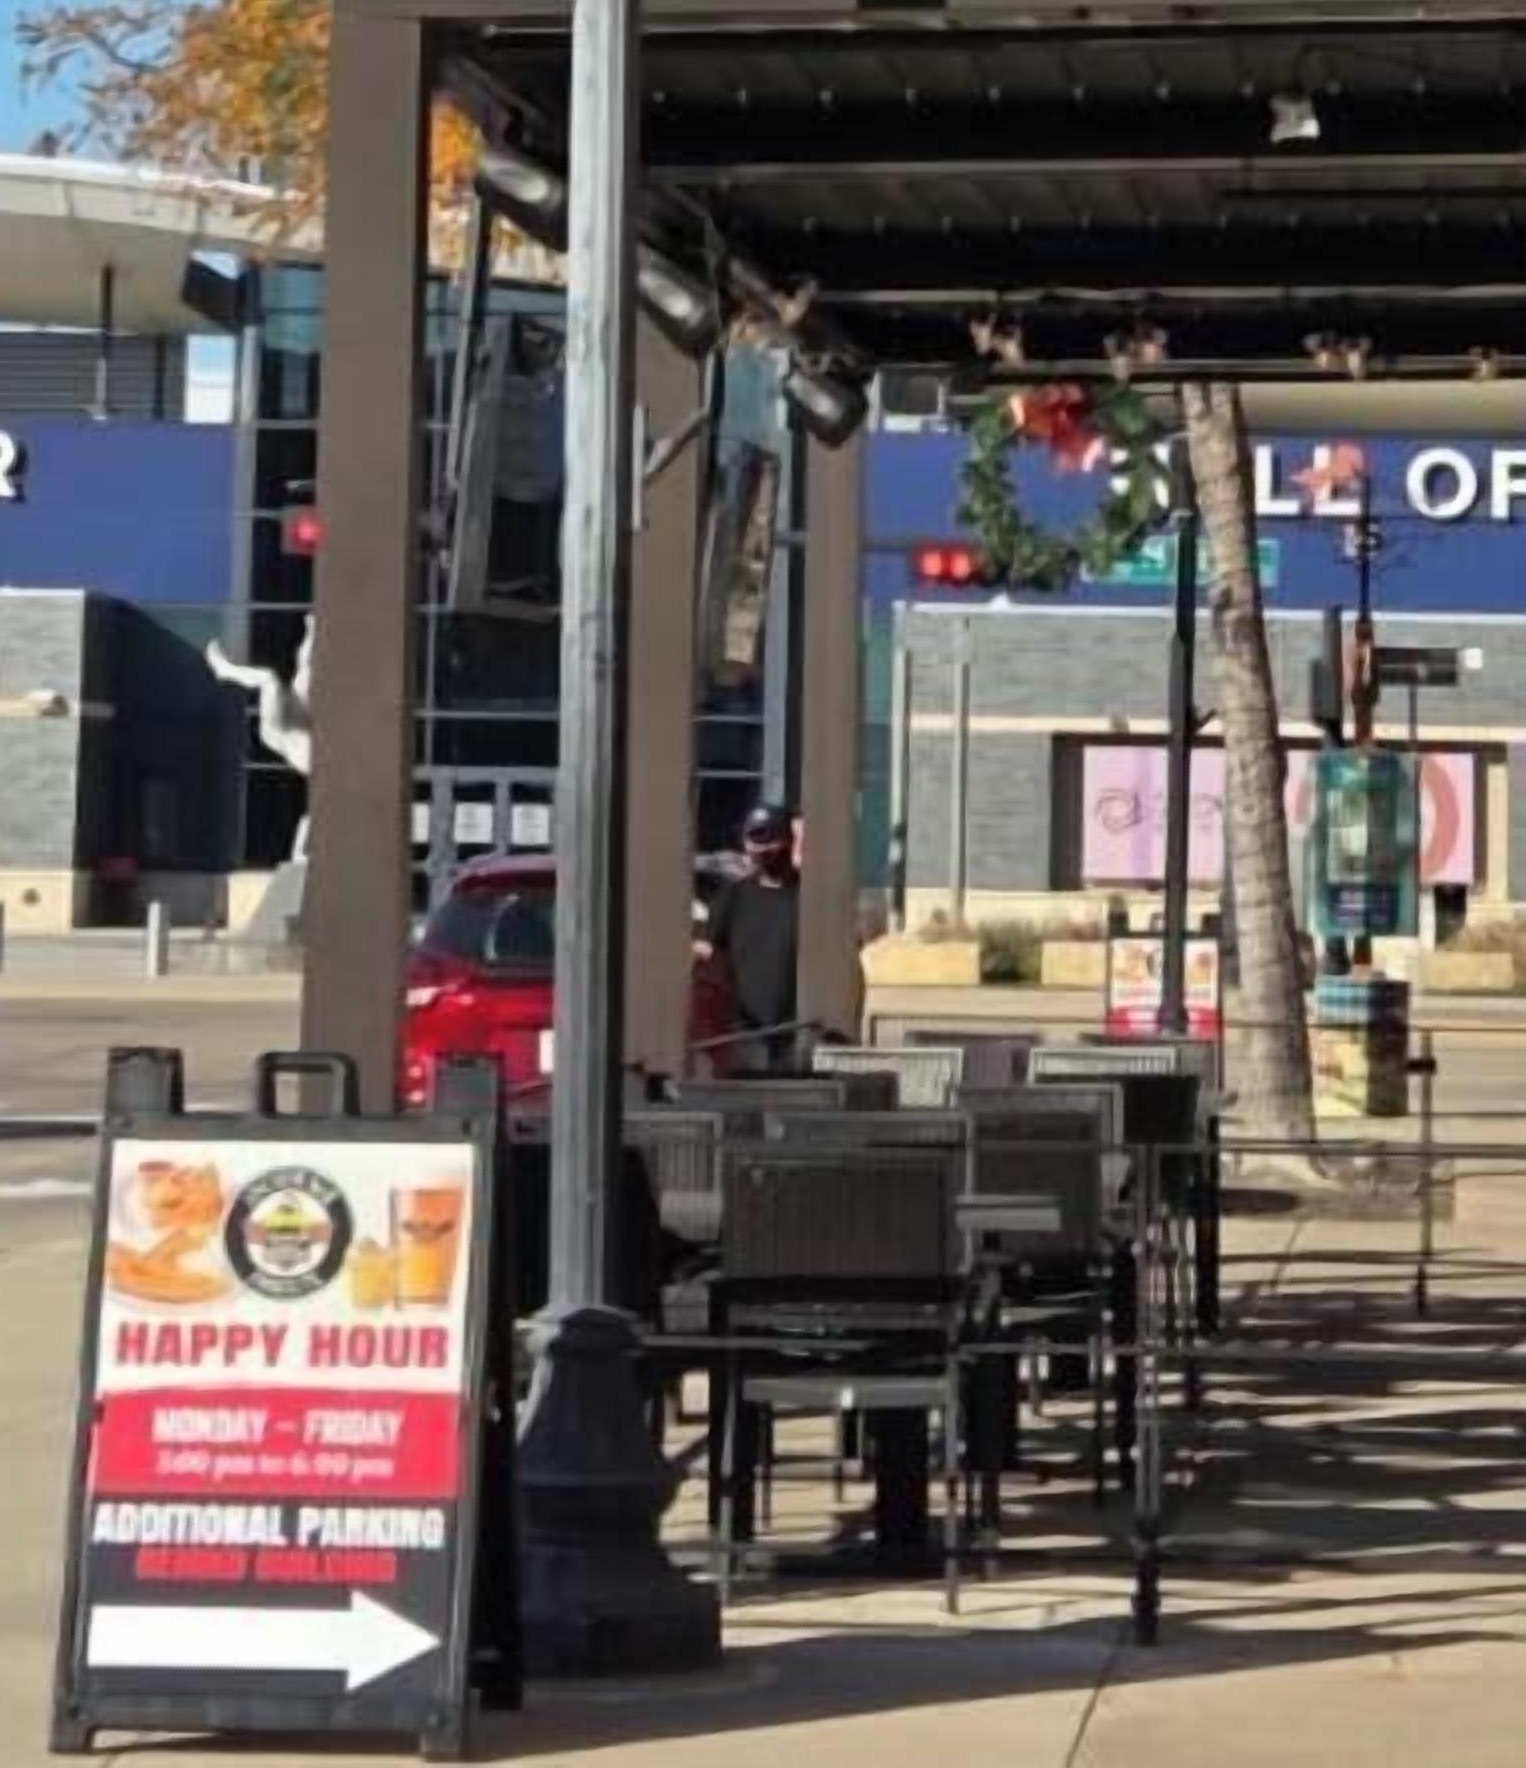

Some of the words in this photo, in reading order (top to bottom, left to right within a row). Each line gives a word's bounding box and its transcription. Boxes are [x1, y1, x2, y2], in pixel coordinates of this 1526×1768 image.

[116, 1320, 288, 1367] HAPPY
[308, 1324, 449, 1368] HOUR
[152, 1407, 267, 1443] MONDAY
[302, 1409, 404, 1446] FRIDAY
[93, 1502, 288, 1547] ADDITIONAL
[297, 1507, 445, 1548] PARKING
